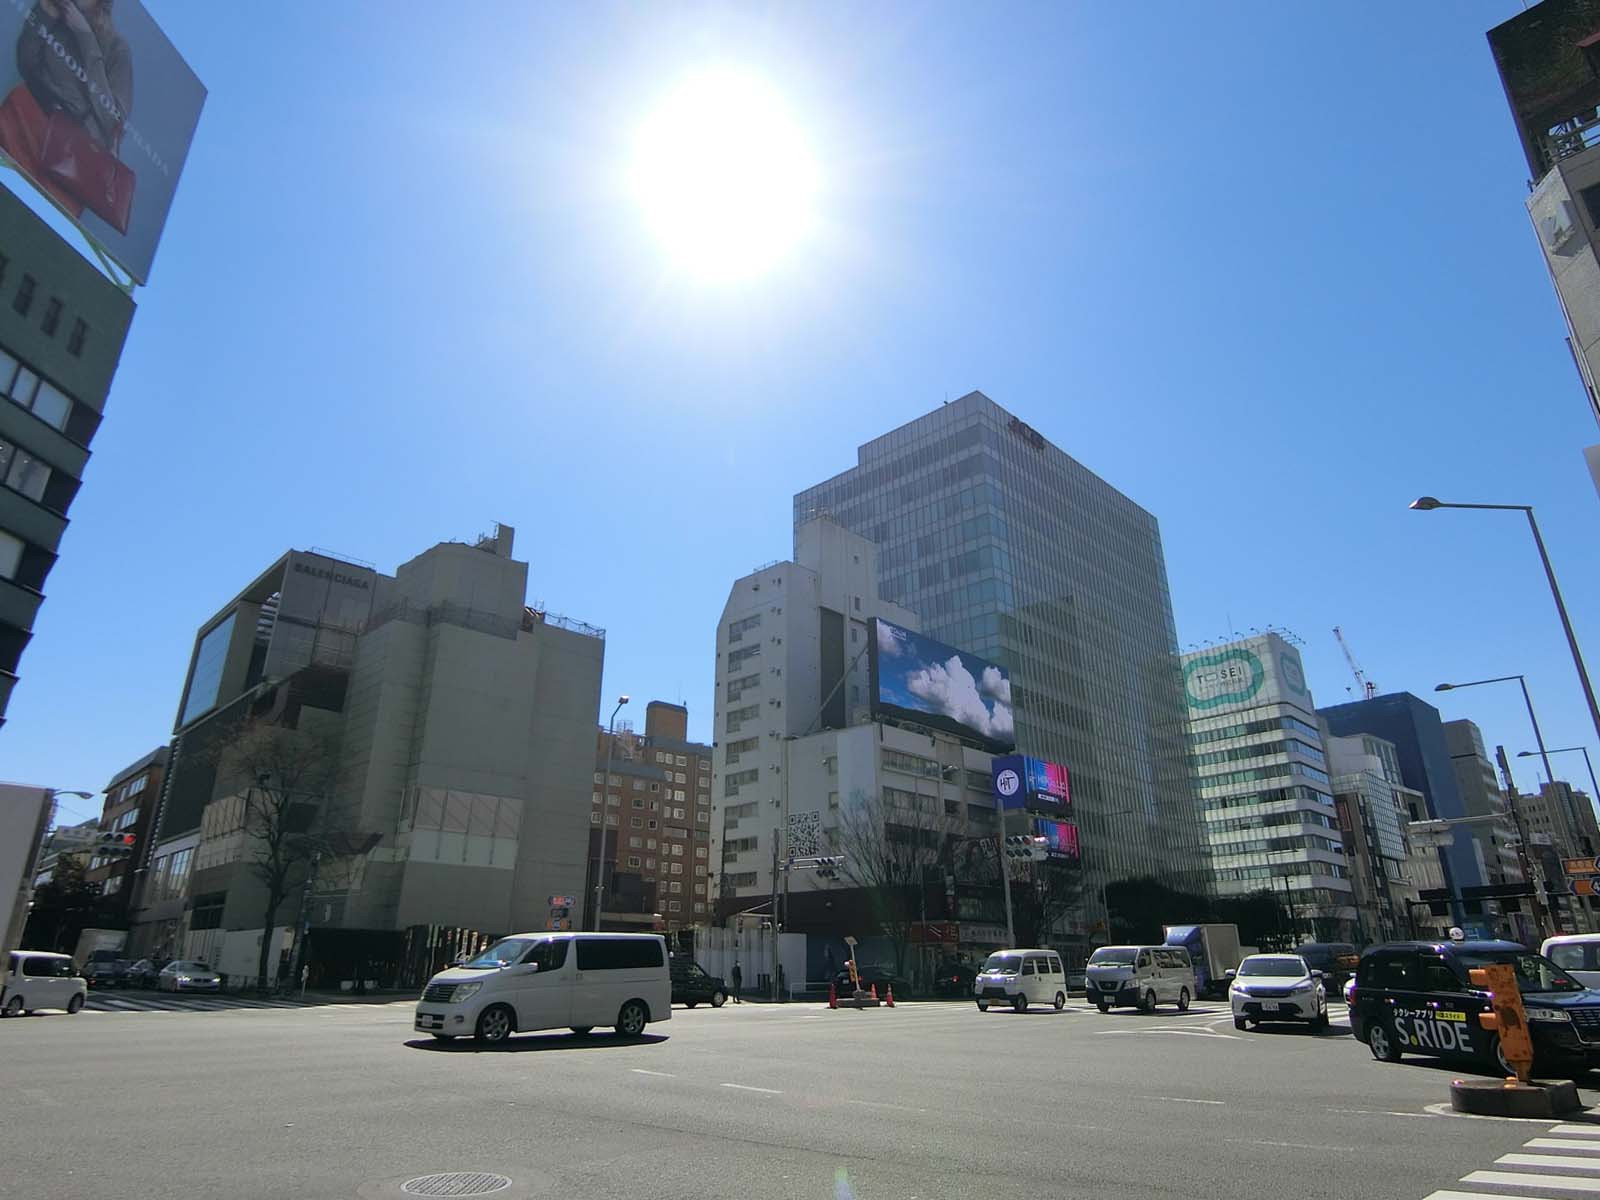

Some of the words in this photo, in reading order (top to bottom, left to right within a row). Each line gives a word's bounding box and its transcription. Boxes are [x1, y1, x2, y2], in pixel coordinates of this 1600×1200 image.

[38, 23, 88, 83] MOOD
[1393, 1008, 1433, 1019] タクシーアプリ
[1394, 1017, 1474, 1053] S.RIDE
